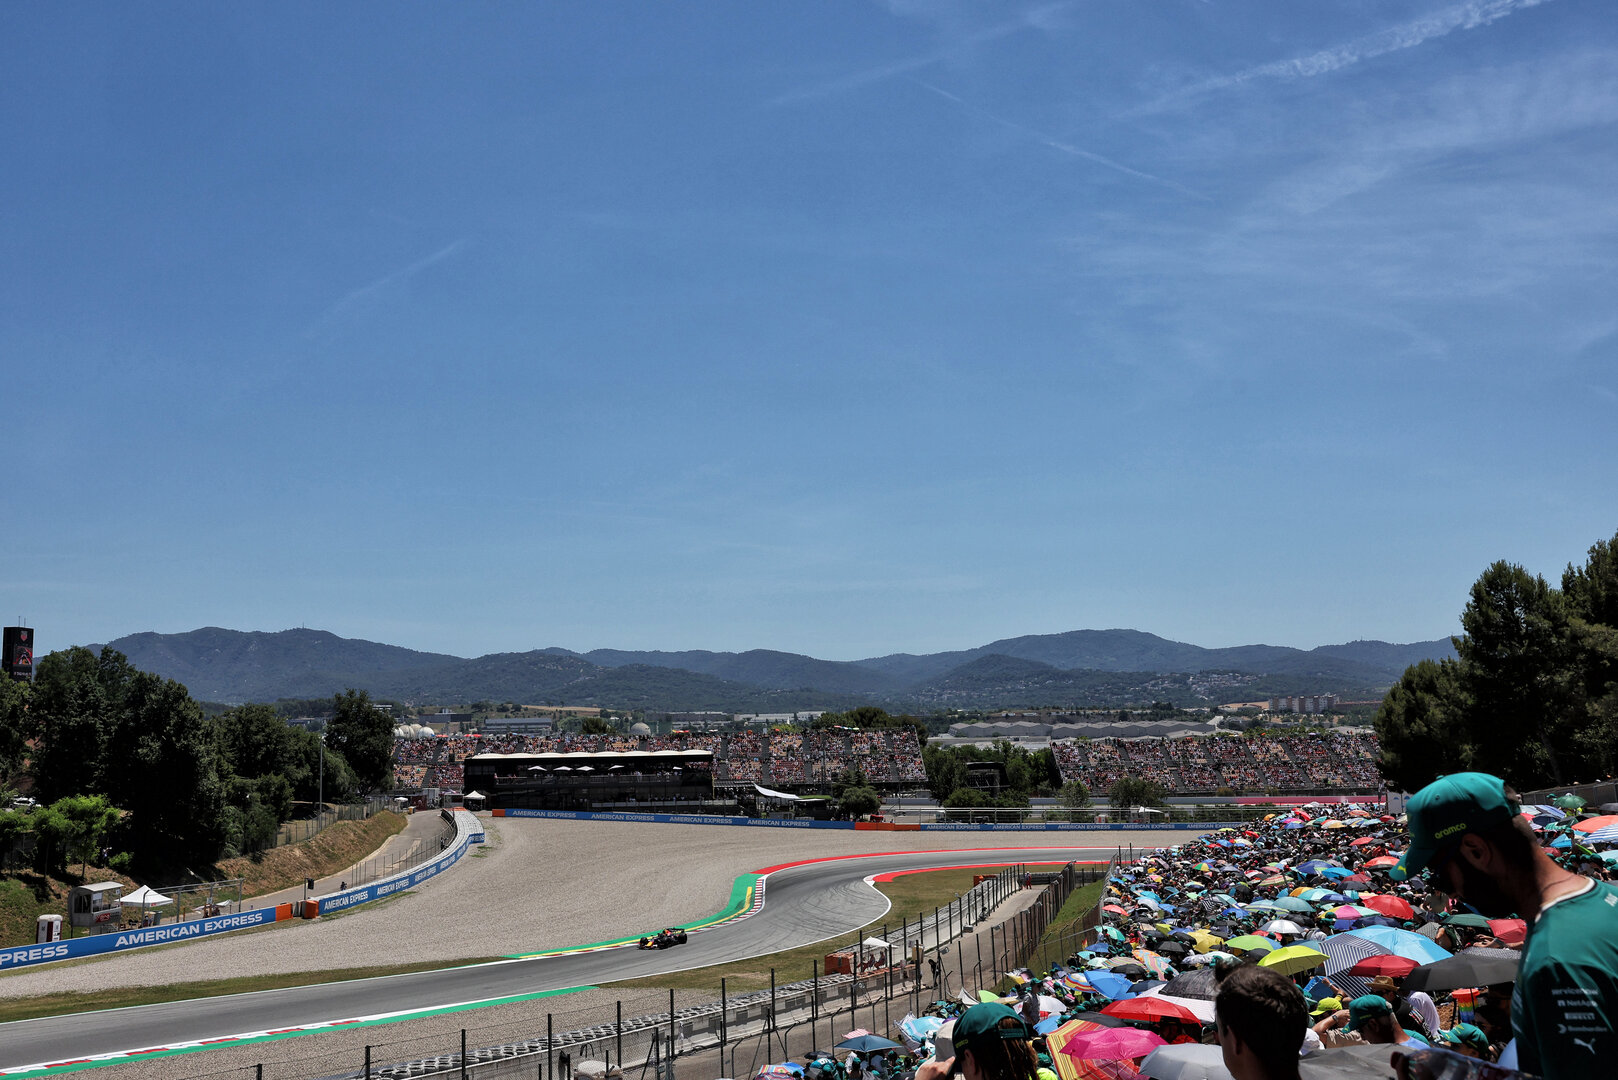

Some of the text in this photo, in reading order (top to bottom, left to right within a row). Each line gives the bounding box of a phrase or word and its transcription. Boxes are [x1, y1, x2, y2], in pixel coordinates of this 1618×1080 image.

[1434, 823, 1466, 839] aramco
[324, 890, 368, 910] AMERICAN EXPRESS
[115, 912, 263, 947] AMERICAN EXPRESS
[0, 944, 68, 965] PRESS
